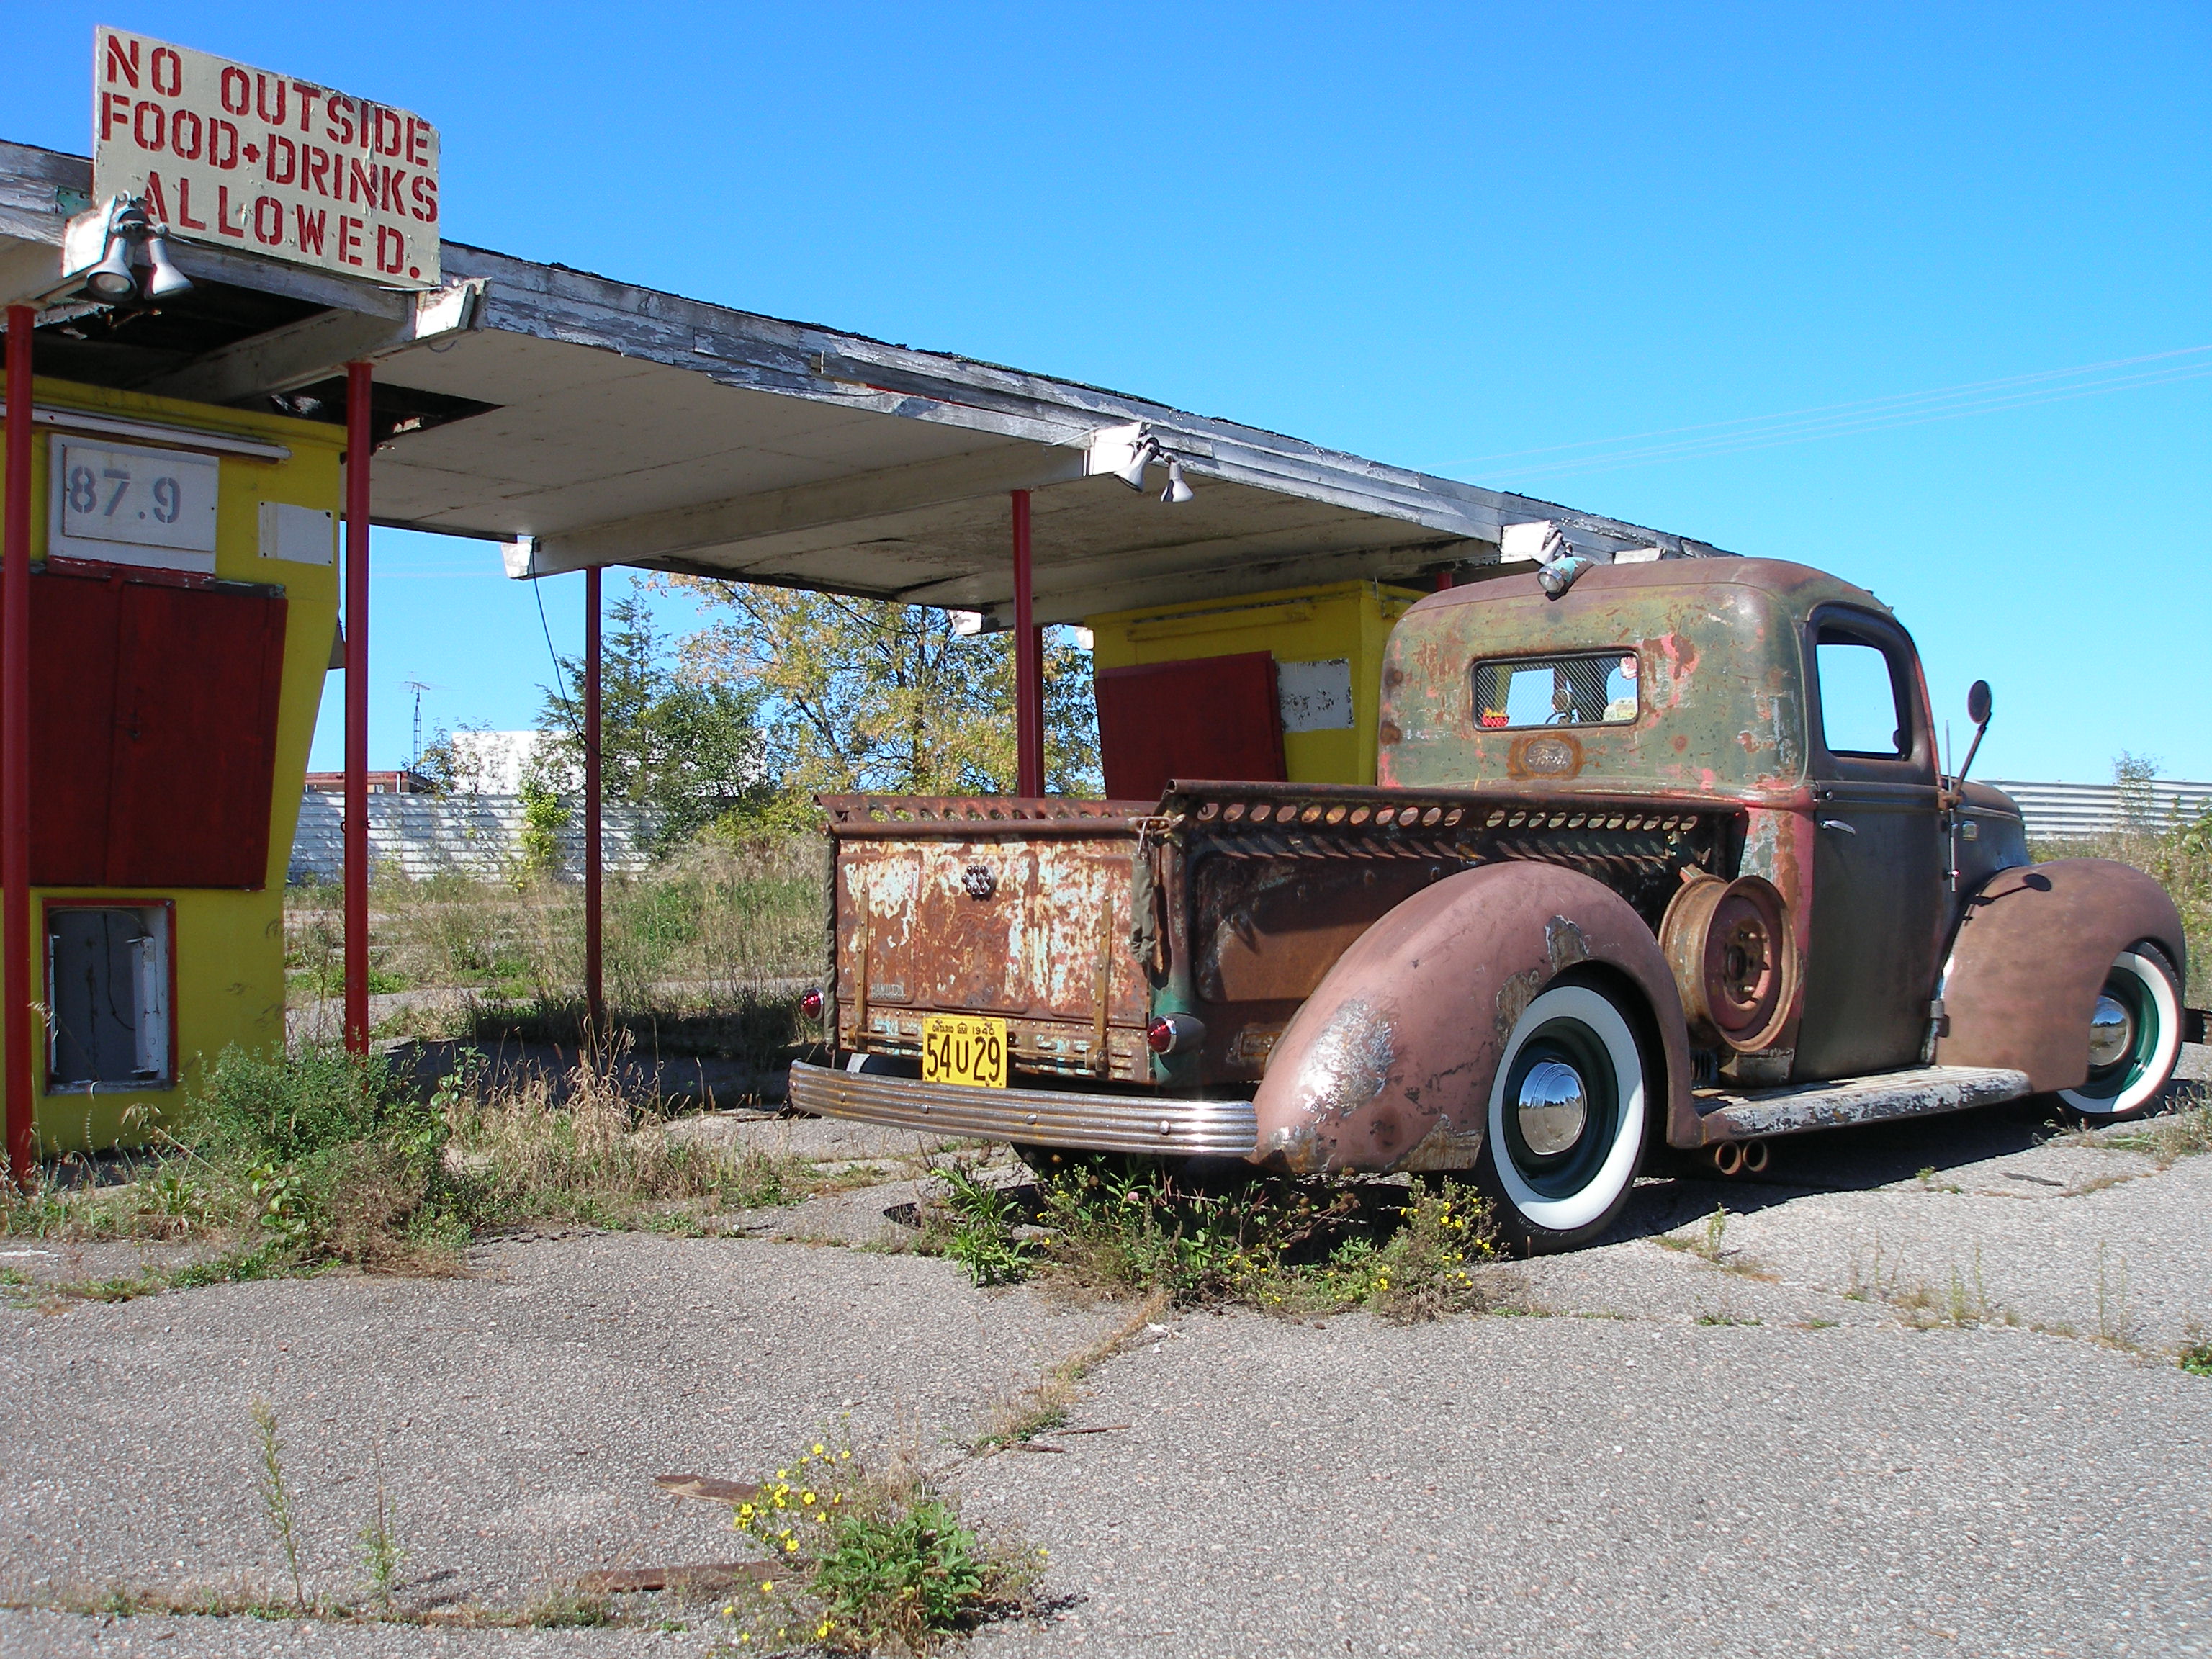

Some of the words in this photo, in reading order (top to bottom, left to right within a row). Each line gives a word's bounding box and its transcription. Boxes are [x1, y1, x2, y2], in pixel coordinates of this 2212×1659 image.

[107, 35, 183, 98] NO
[220, 66, 431, 167] OUTSIDE
[144, 171, 422, 280] ALLOWED.
[71, 466, 182, 524] 87.9
[932, 1023, 955, 1034] ONTARIO
[972, 1025, 995, 1035] 1940
